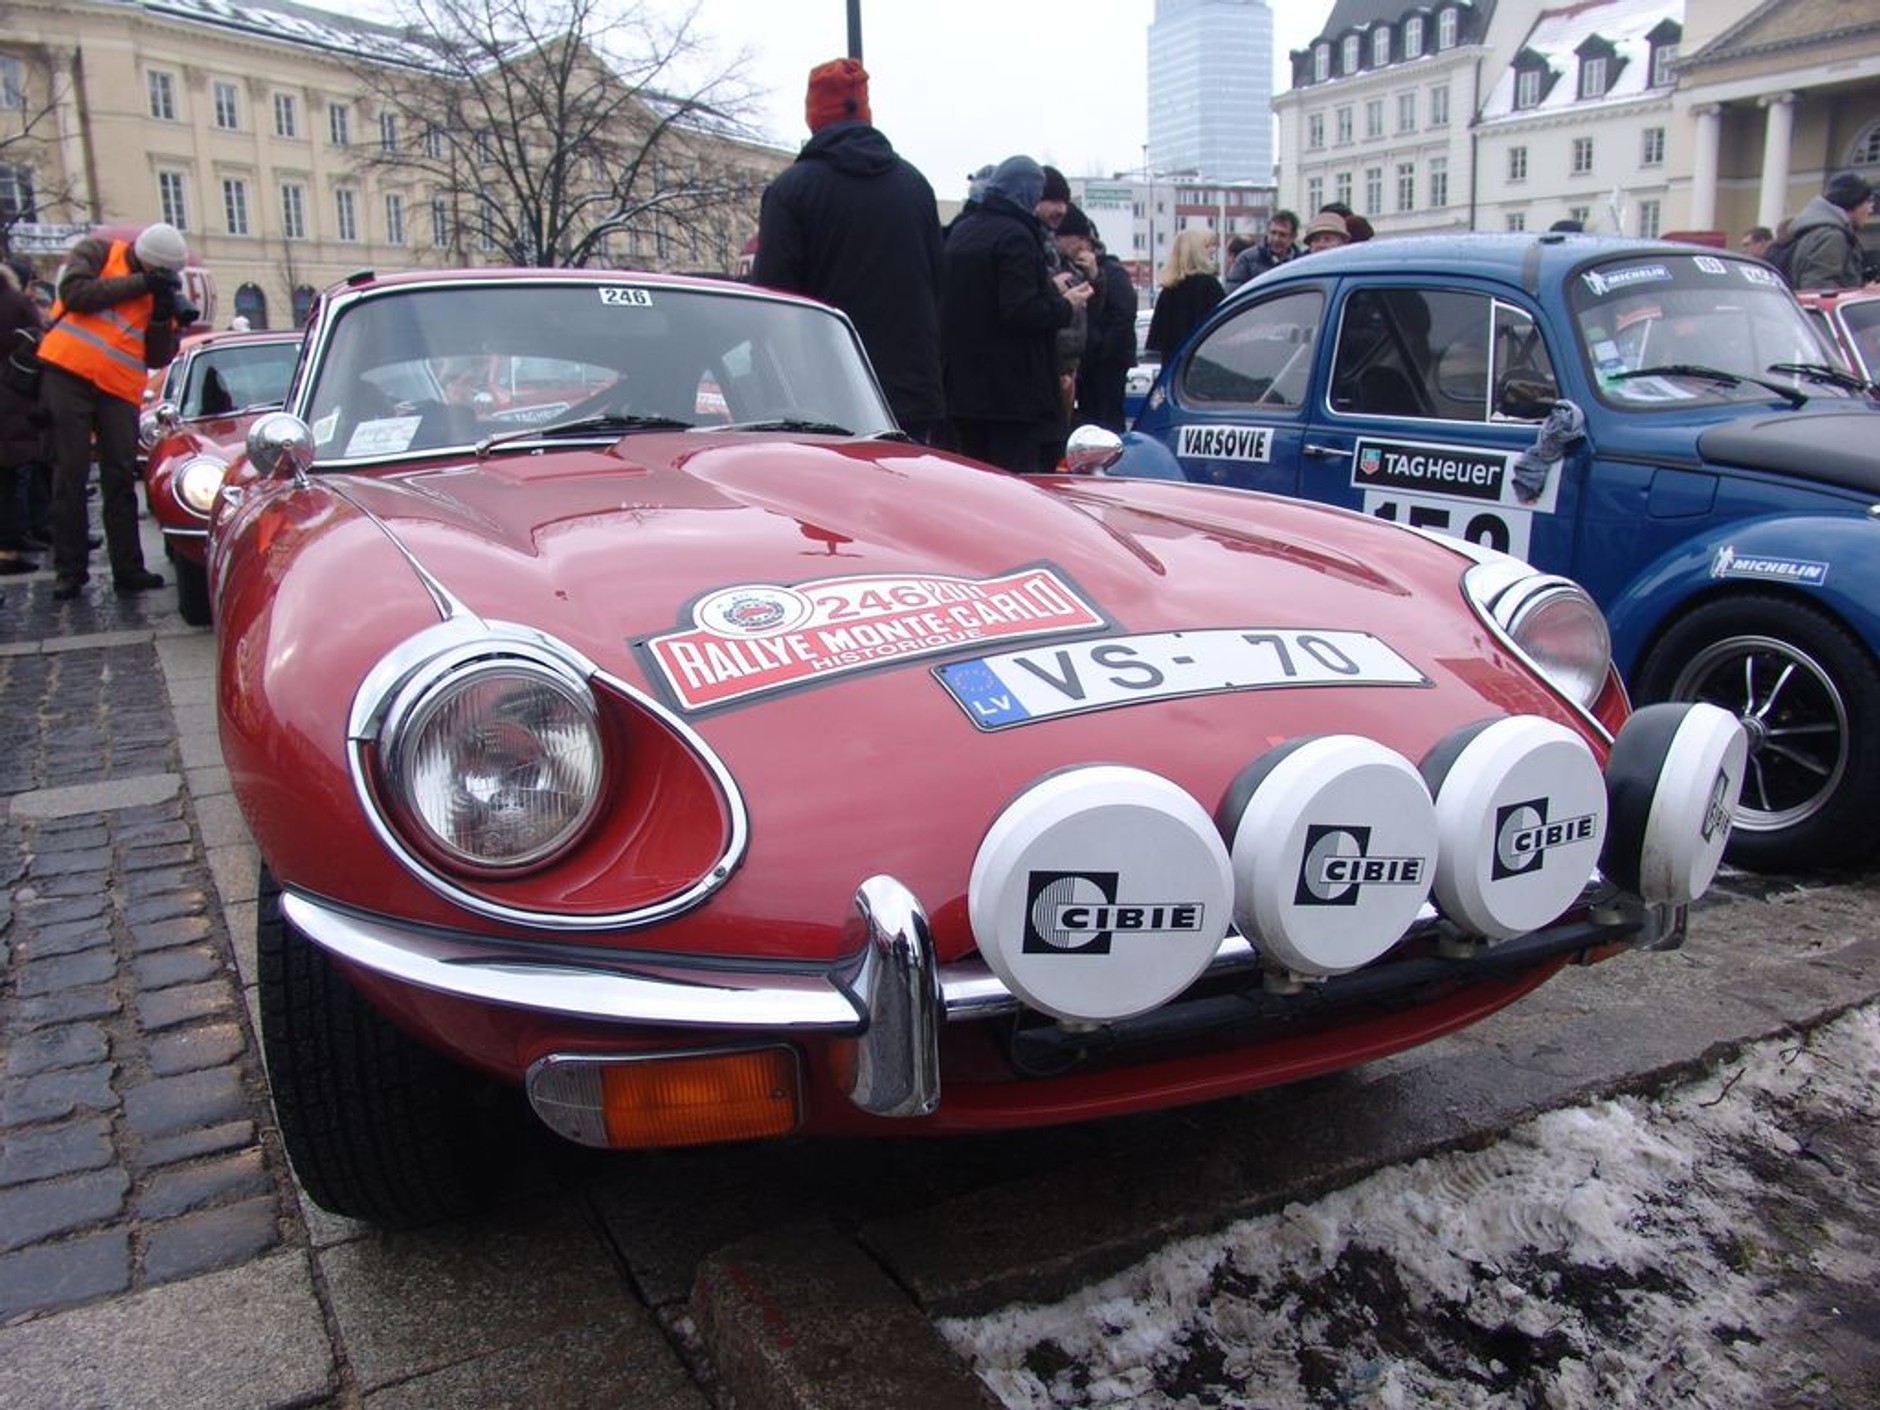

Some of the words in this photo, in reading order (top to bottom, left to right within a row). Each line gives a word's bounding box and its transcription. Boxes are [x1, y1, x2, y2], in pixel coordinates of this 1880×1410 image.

[1607, 267, 1664, 284] MICHELIN
[605, 289, 646, 304] 246
[1185, 428, 1266, 458] VARSOVIE
[1733, 559, 1822, 578] MICHELIN
[817, 585, 929, 620] 246
[921, 579, 988, 605] 2011
[667, 633, 819, 689] RALLYE
[811, 627, 985, 671] HISTORIQUE
[973, 695, 1013, 716] LV
[1241, 634, 1361, 677] 70
